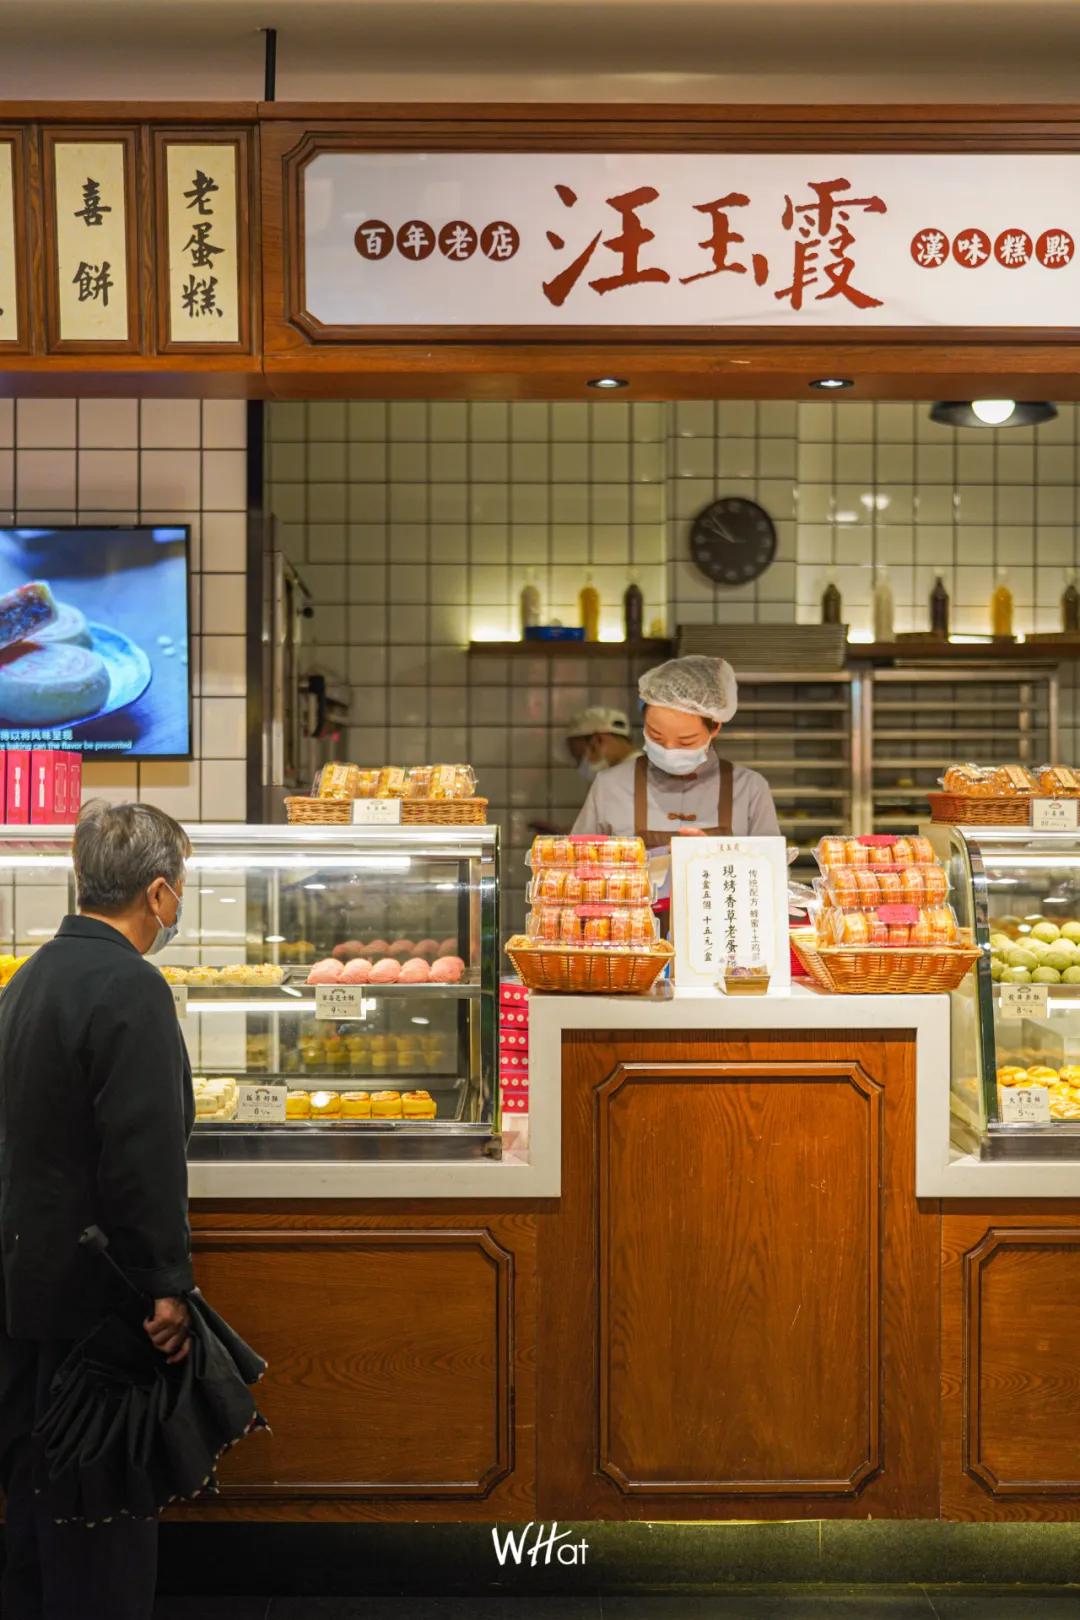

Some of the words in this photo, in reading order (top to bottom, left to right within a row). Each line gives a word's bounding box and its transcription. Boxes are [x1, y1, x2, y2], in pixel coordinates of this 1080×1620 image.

[72, 177, 114, 307] 喜餅
[182, 170, 225, 318] 老蛋糕
[357, 222, 517, 260] 百年老店
[542, 177, 887, 311] 汪玉霞
[913, 231, 1073, 267] 漢味糕點
[84, 740, 94, 750] be
